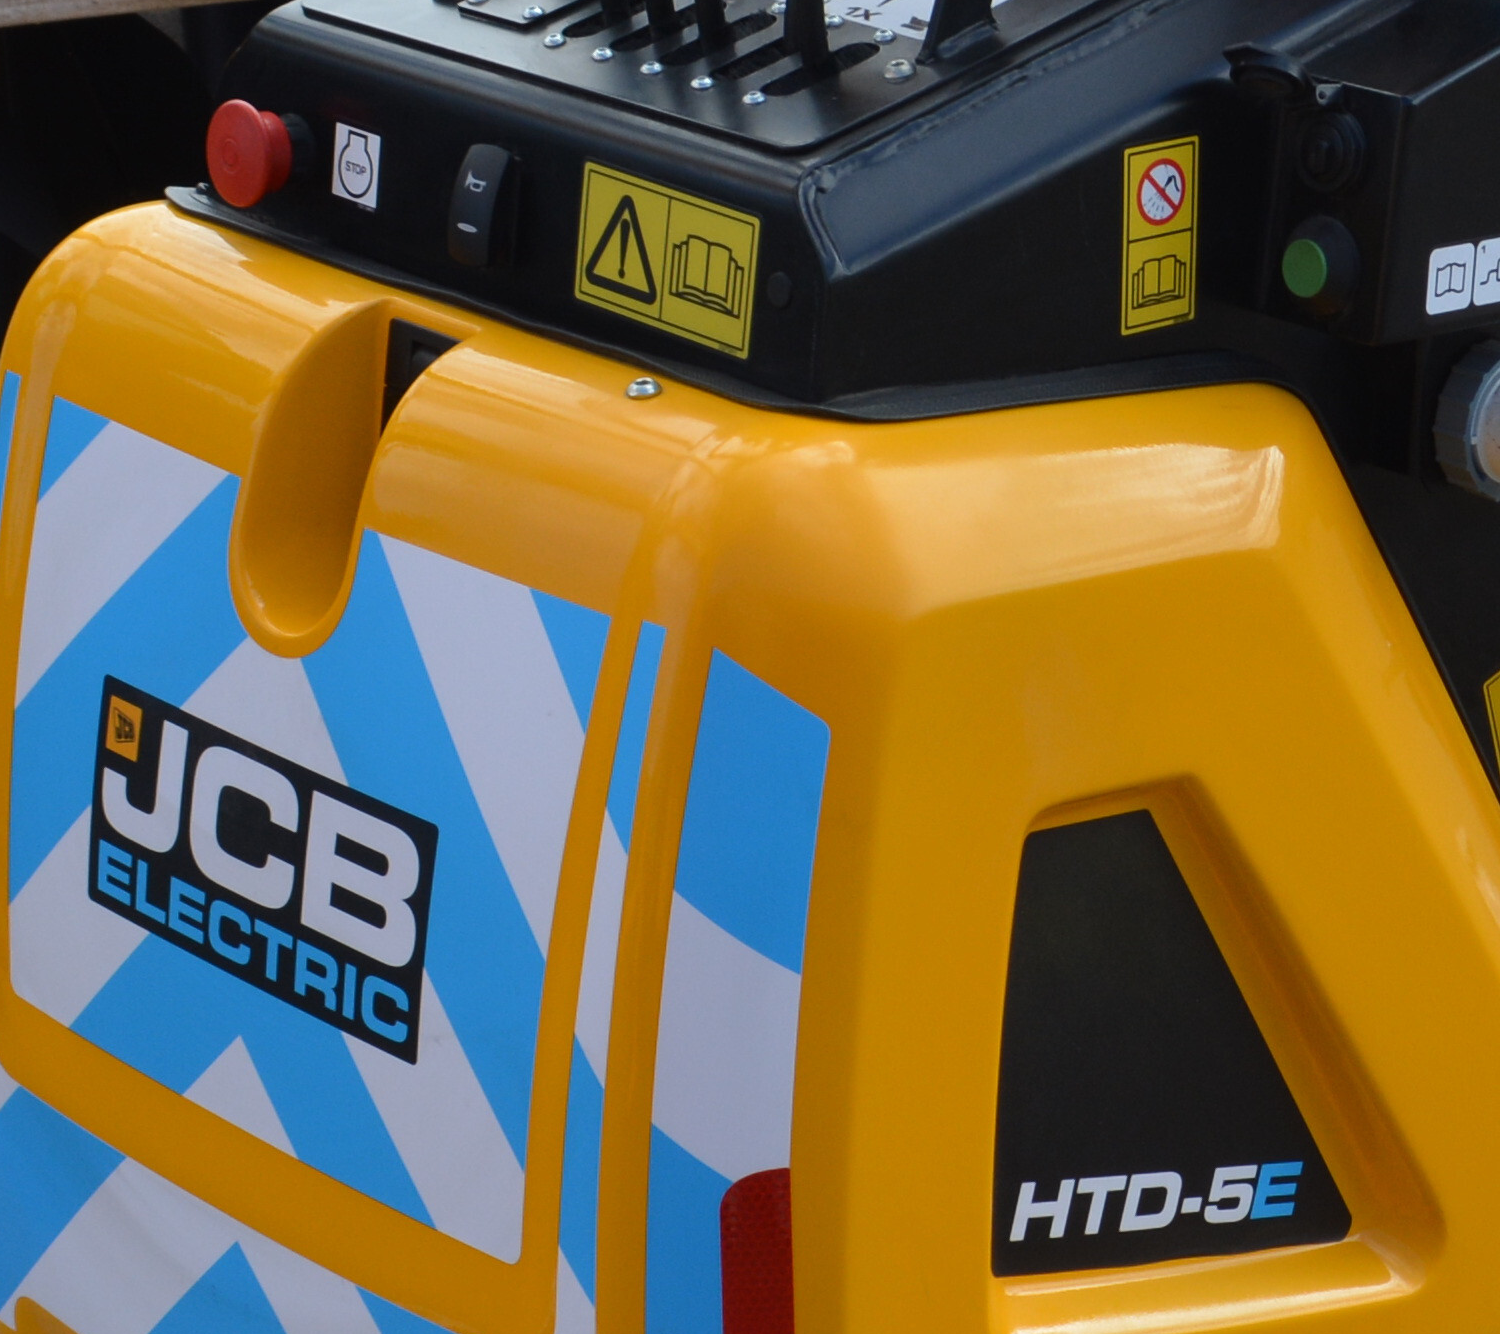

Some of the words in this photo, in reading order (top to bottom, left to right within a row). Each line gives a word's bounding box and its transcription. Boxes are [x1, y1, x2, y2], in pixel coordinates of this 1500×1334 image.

[345, 160, 367, 175] STOP
[102, 719, 420, 967] JCB
[97, 838, 409, 1044] ELECTRIC
[1009, 1161, 1304, 1243] HTD-5E
